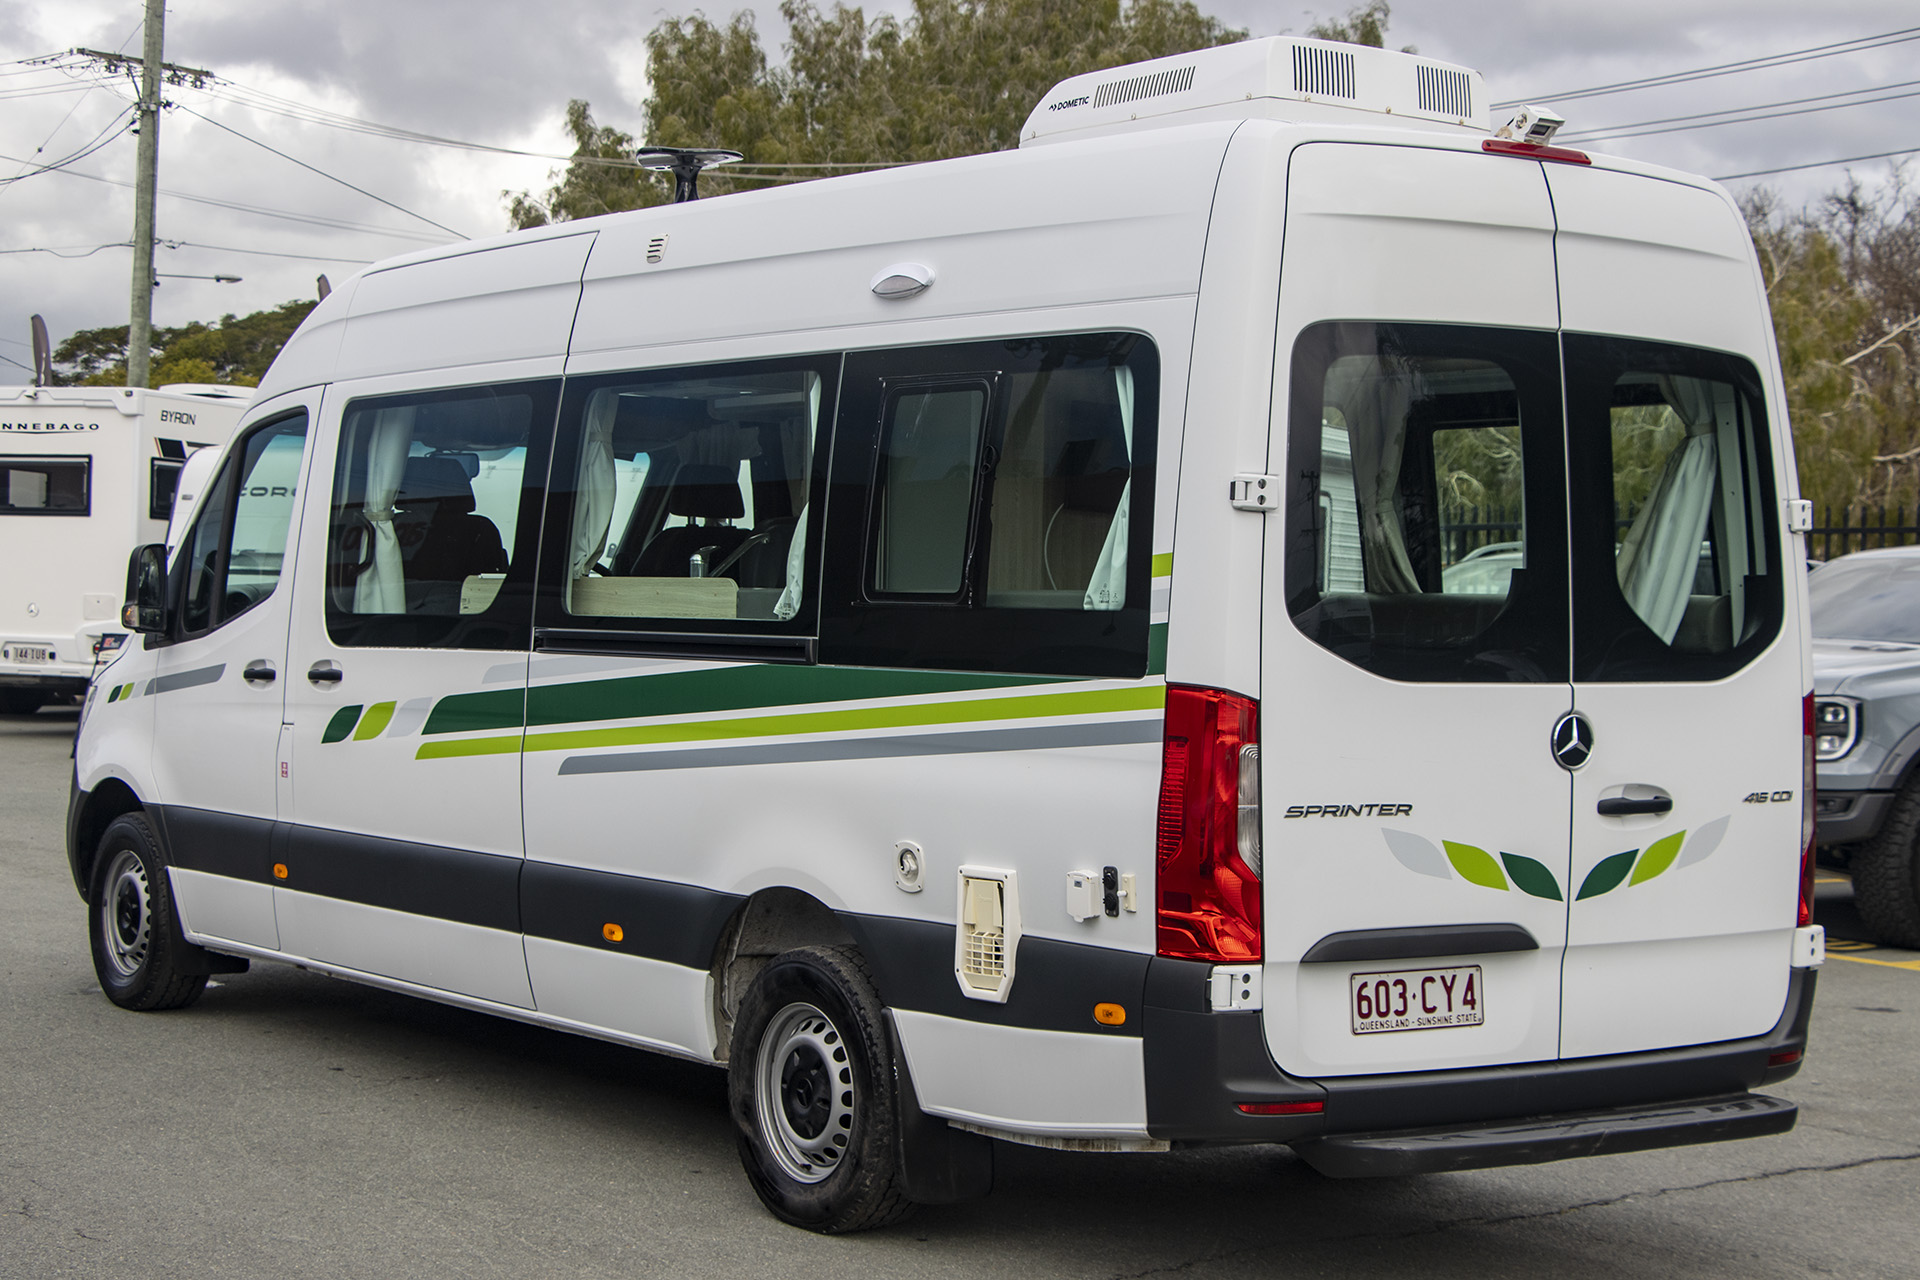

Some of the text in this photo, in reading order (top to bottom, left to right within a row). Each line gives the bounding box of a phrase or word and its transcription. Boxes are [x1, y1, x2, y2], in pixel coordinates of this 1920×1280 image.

[1057, 95, 1090, 111] DOMETIC
[160, 409, 197, 426] BYRON
[240, 486, 297, 497] OR
[1742, 790, 1794, 804] 416 CDI
[1283, 803, 1413, 819] SPRINTER
[1359, 1018, 1410, 1031] QUEENSLAND
[1416, 1014, 1453, 1027] SUNSHINE
[1456, 1013, 1477, 1024] STATE
